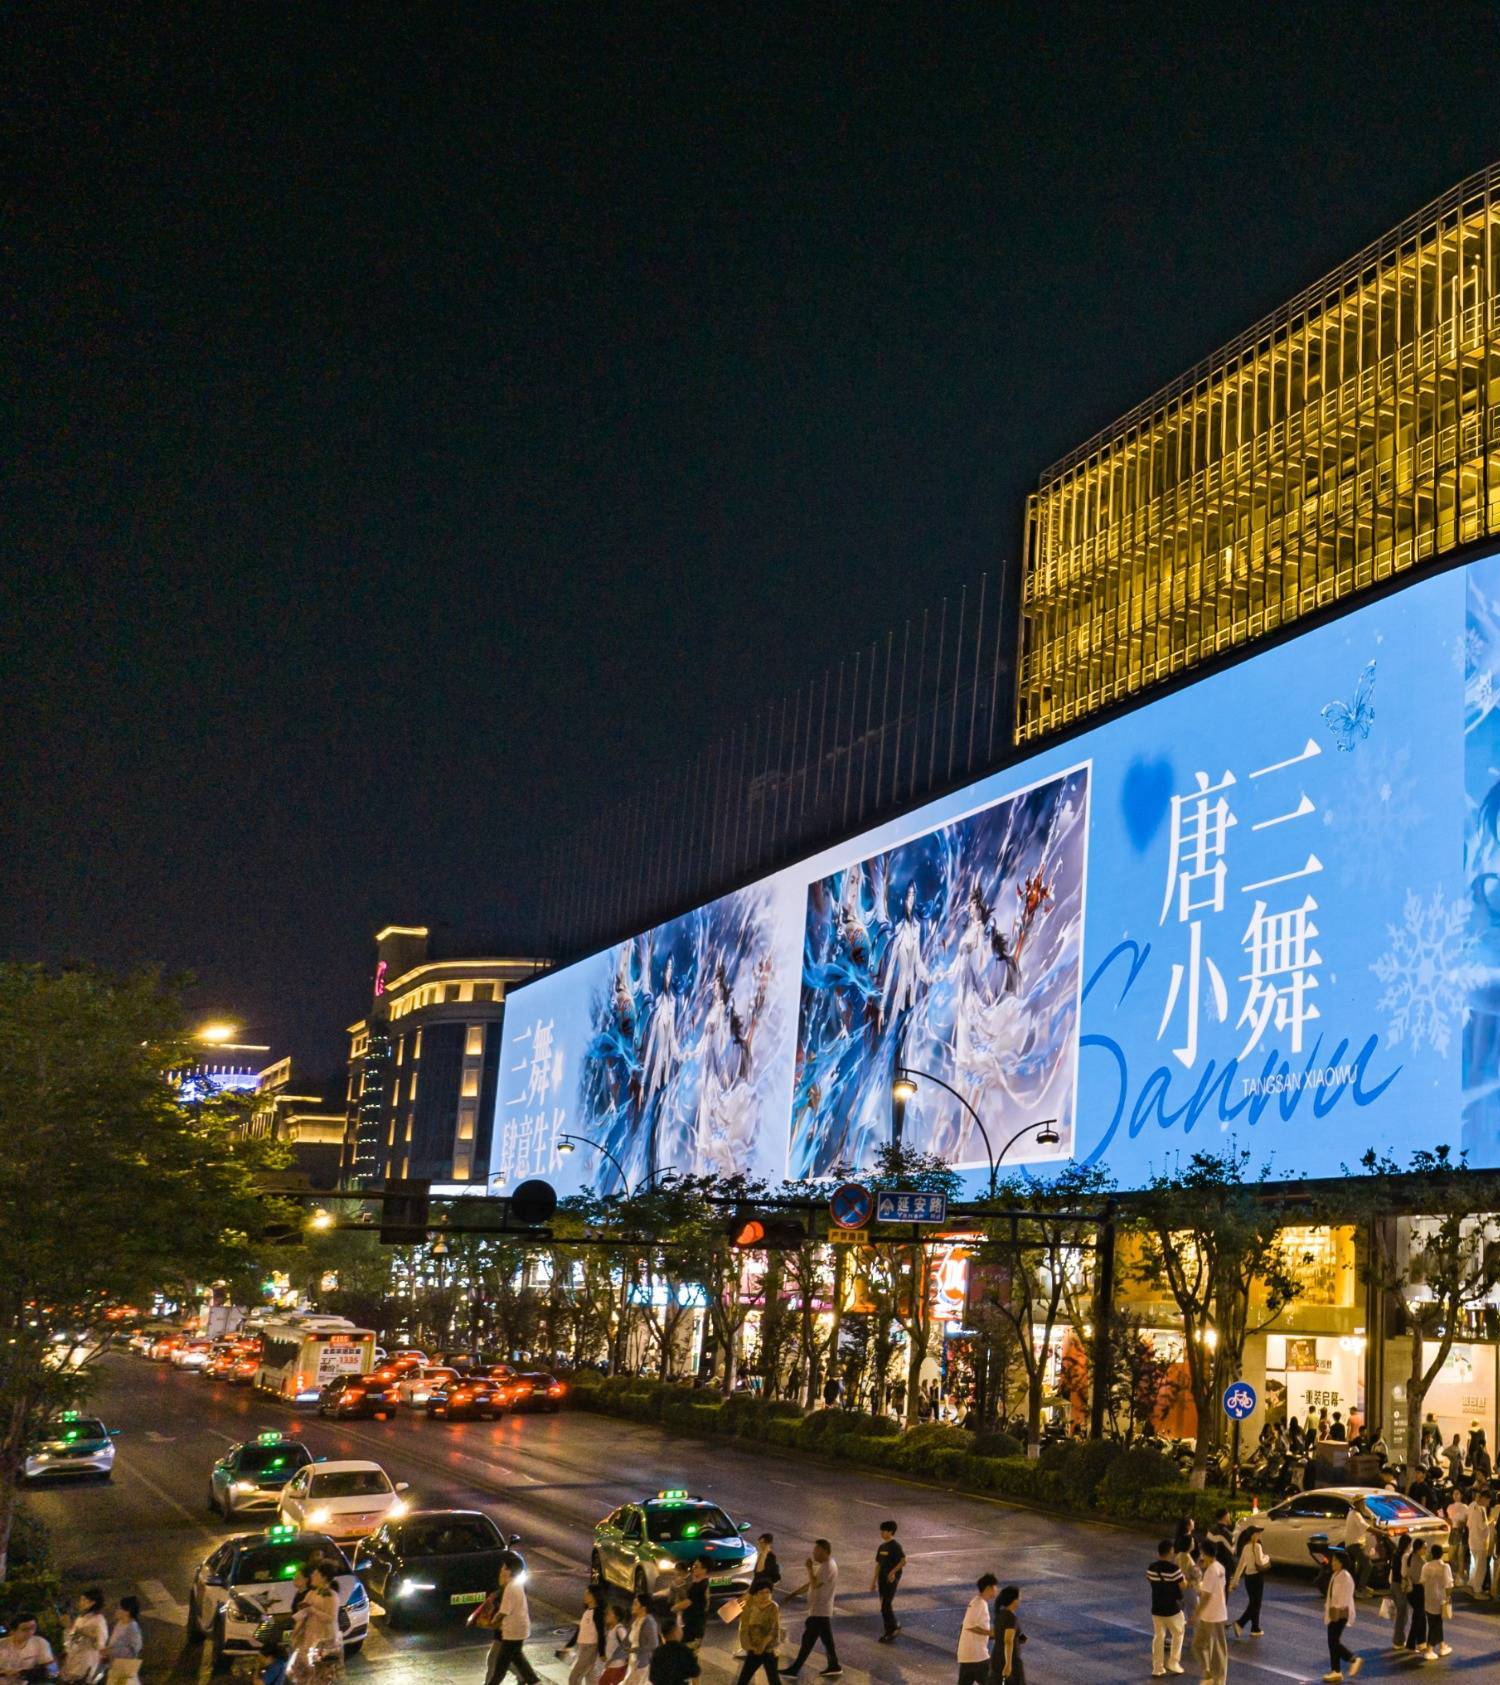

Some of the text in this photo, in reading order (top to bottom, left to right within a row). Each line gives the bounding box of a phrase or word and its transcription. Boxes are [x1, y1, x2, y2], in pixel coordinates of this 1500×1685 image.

[1242, 1064, 1358, 1098] TANGSAN XIAOWU
[897, 1195, 942, 1214] 延安路
